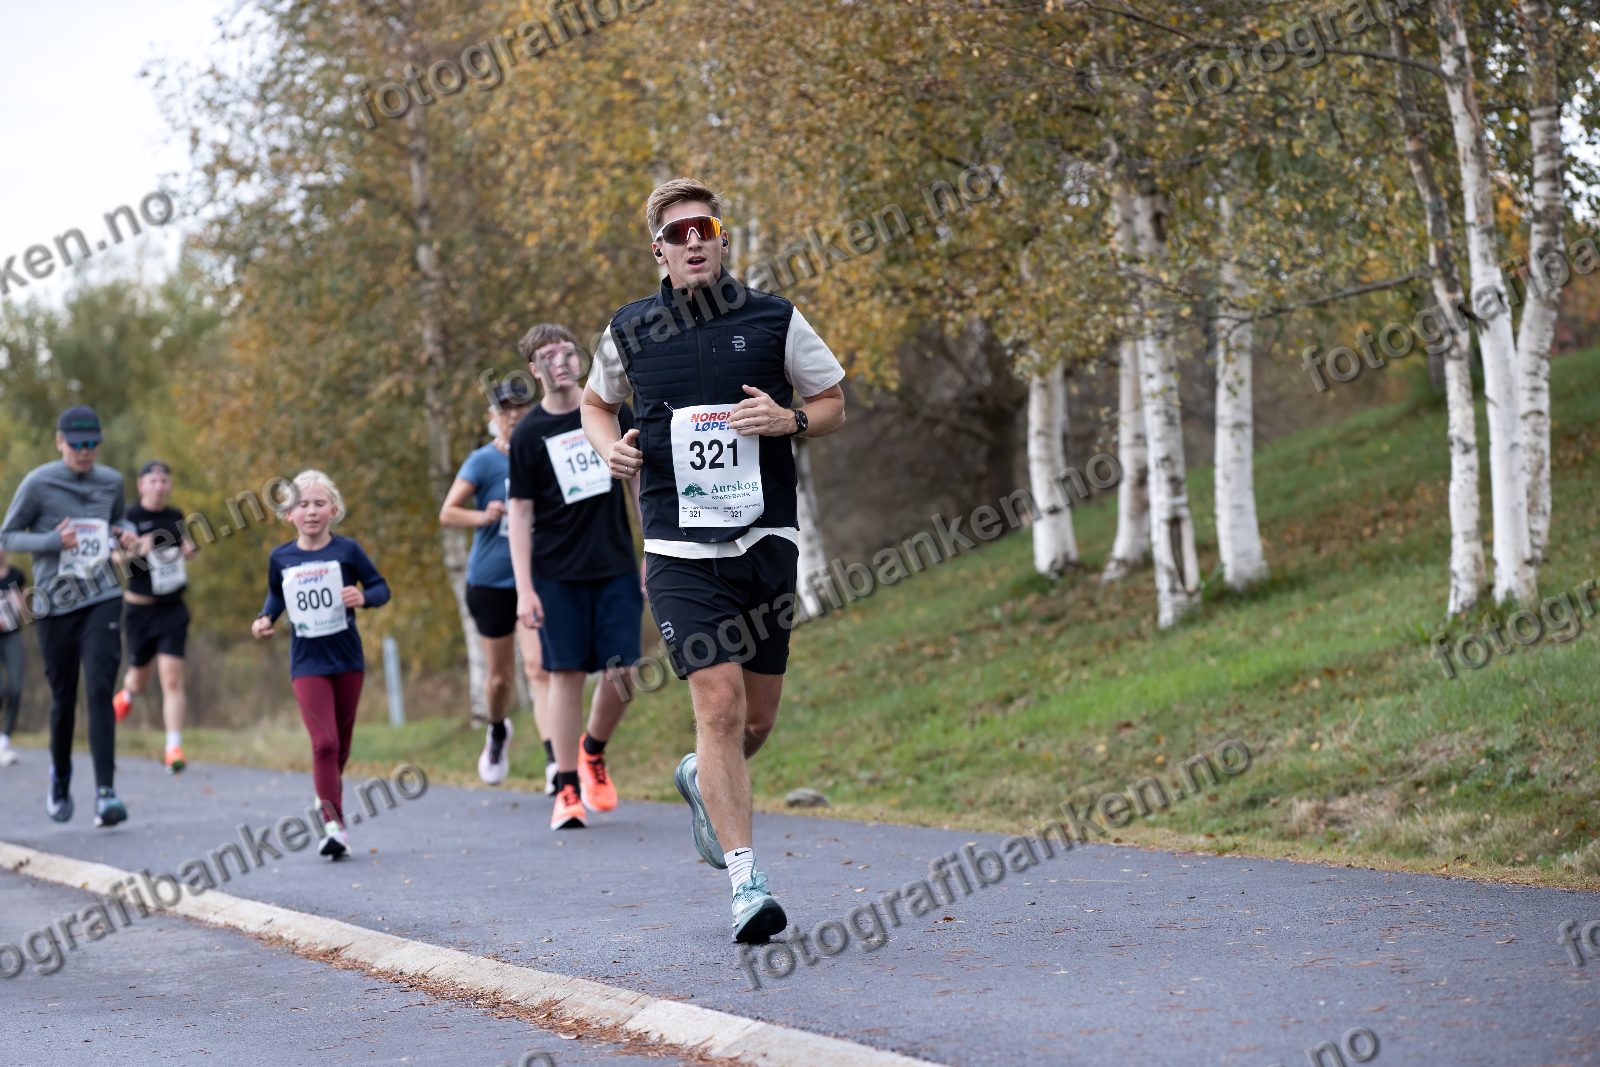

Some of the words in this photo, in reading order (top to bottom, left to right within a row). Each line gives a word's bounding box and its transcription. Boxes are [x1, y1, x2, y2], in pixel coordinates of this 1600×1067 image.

[695, 421, 730, 432] LØPE
[566, 450, 600, 475] 194
[689, 438, 738, 471] 321
[711, 480, 759, 494] Aurskog
[296, 587, 333, 611] 800
